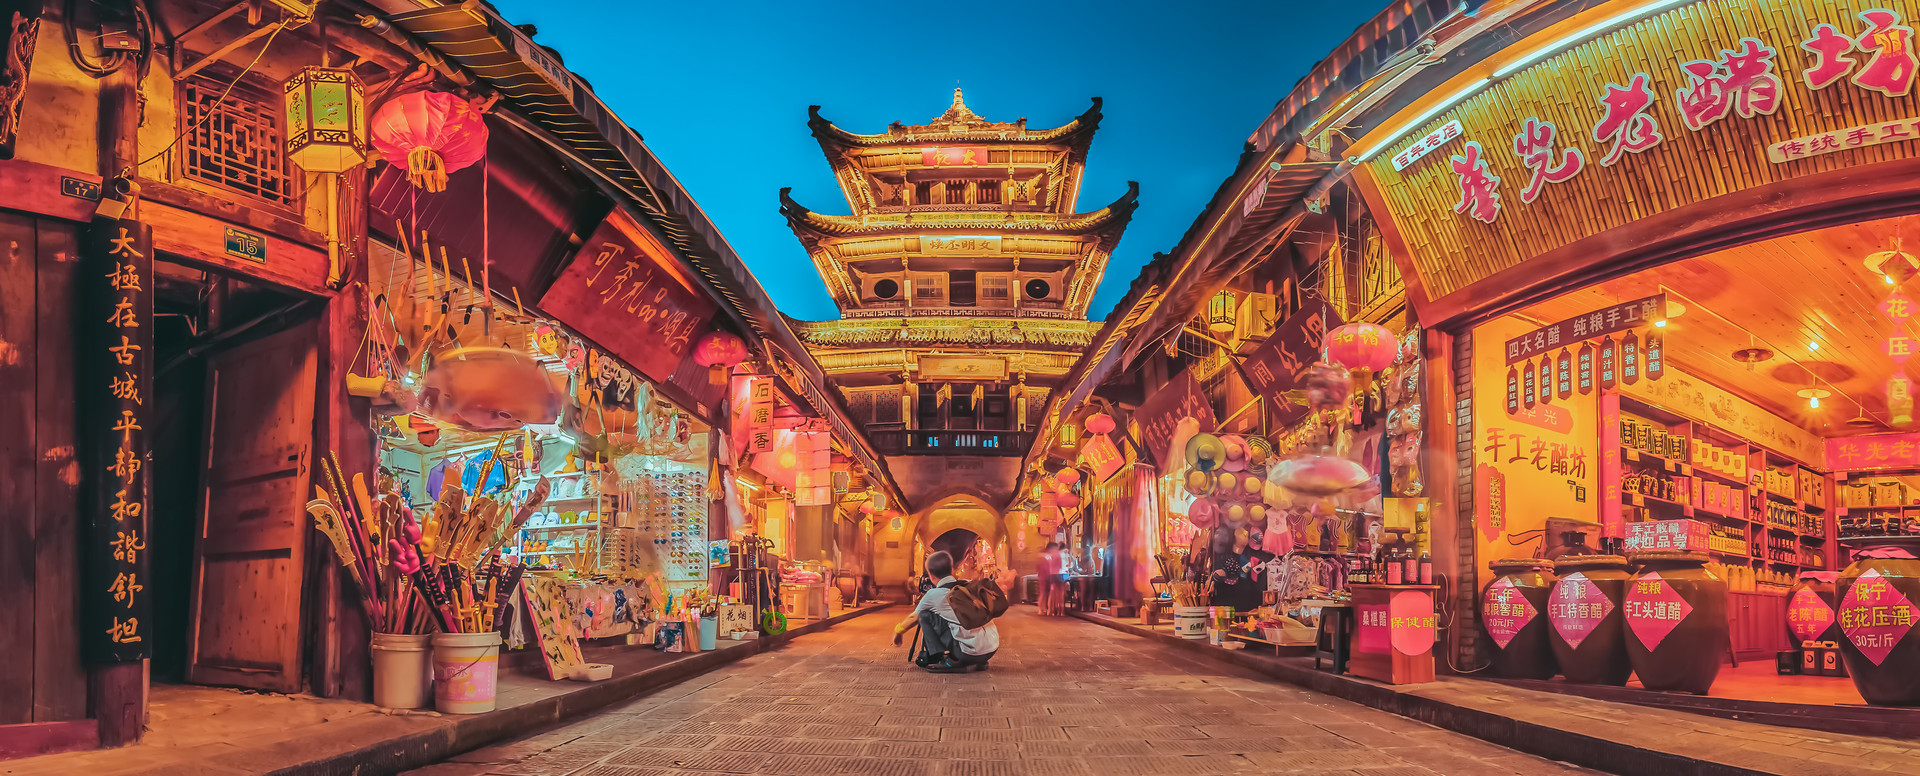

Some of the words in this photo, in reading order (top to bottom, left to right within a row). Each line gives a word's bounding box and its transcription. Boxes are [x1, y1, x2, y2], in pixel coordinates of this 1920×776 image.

[1395, 123, 1457, 167] 百年老店
[75, 187, 88, 196] 17
[236, 238, 258, 255] 15
[1573, 298, 1657, 337] 纯粮手工醋
[1333, 327, 1381, 346] 和谐
[1509, 325, 1560, 359] 四大名醋
[1602, 348, 1613, 381] 原汁醋
[1624, 343, 1635, 377] 特香醋
[1648, 338, 1660, 372] 头道醋
[1560, 360, 1569, 392] 老陈醋
[753, 382, 770, 449] 石磨香
[1484, 427, 1588, 479] 手工老醋坊
[1625, 531, 1688, 550] 欢迎品尝
[1490, 588, 1514, 601] 五年
[1637, 581, 1662, 595] 纯粮
[1855, 582, 1887, 601] 保宁
[1796, 594, 1817, 604] 手工
[1551, 602, 1603, 619] 手工特香醋
[1625, 600, 1682, 621] 手工头道醋
[1789, 607, 1828, 621] 老陈醋
[1840, 604, 1911, 629] 桂花压酒
[1390, 616, 1435, 629] 保健醋
[1796, 623, 1817, 634] 五年
[1855, 633, 1894, 648] 30元/斤
